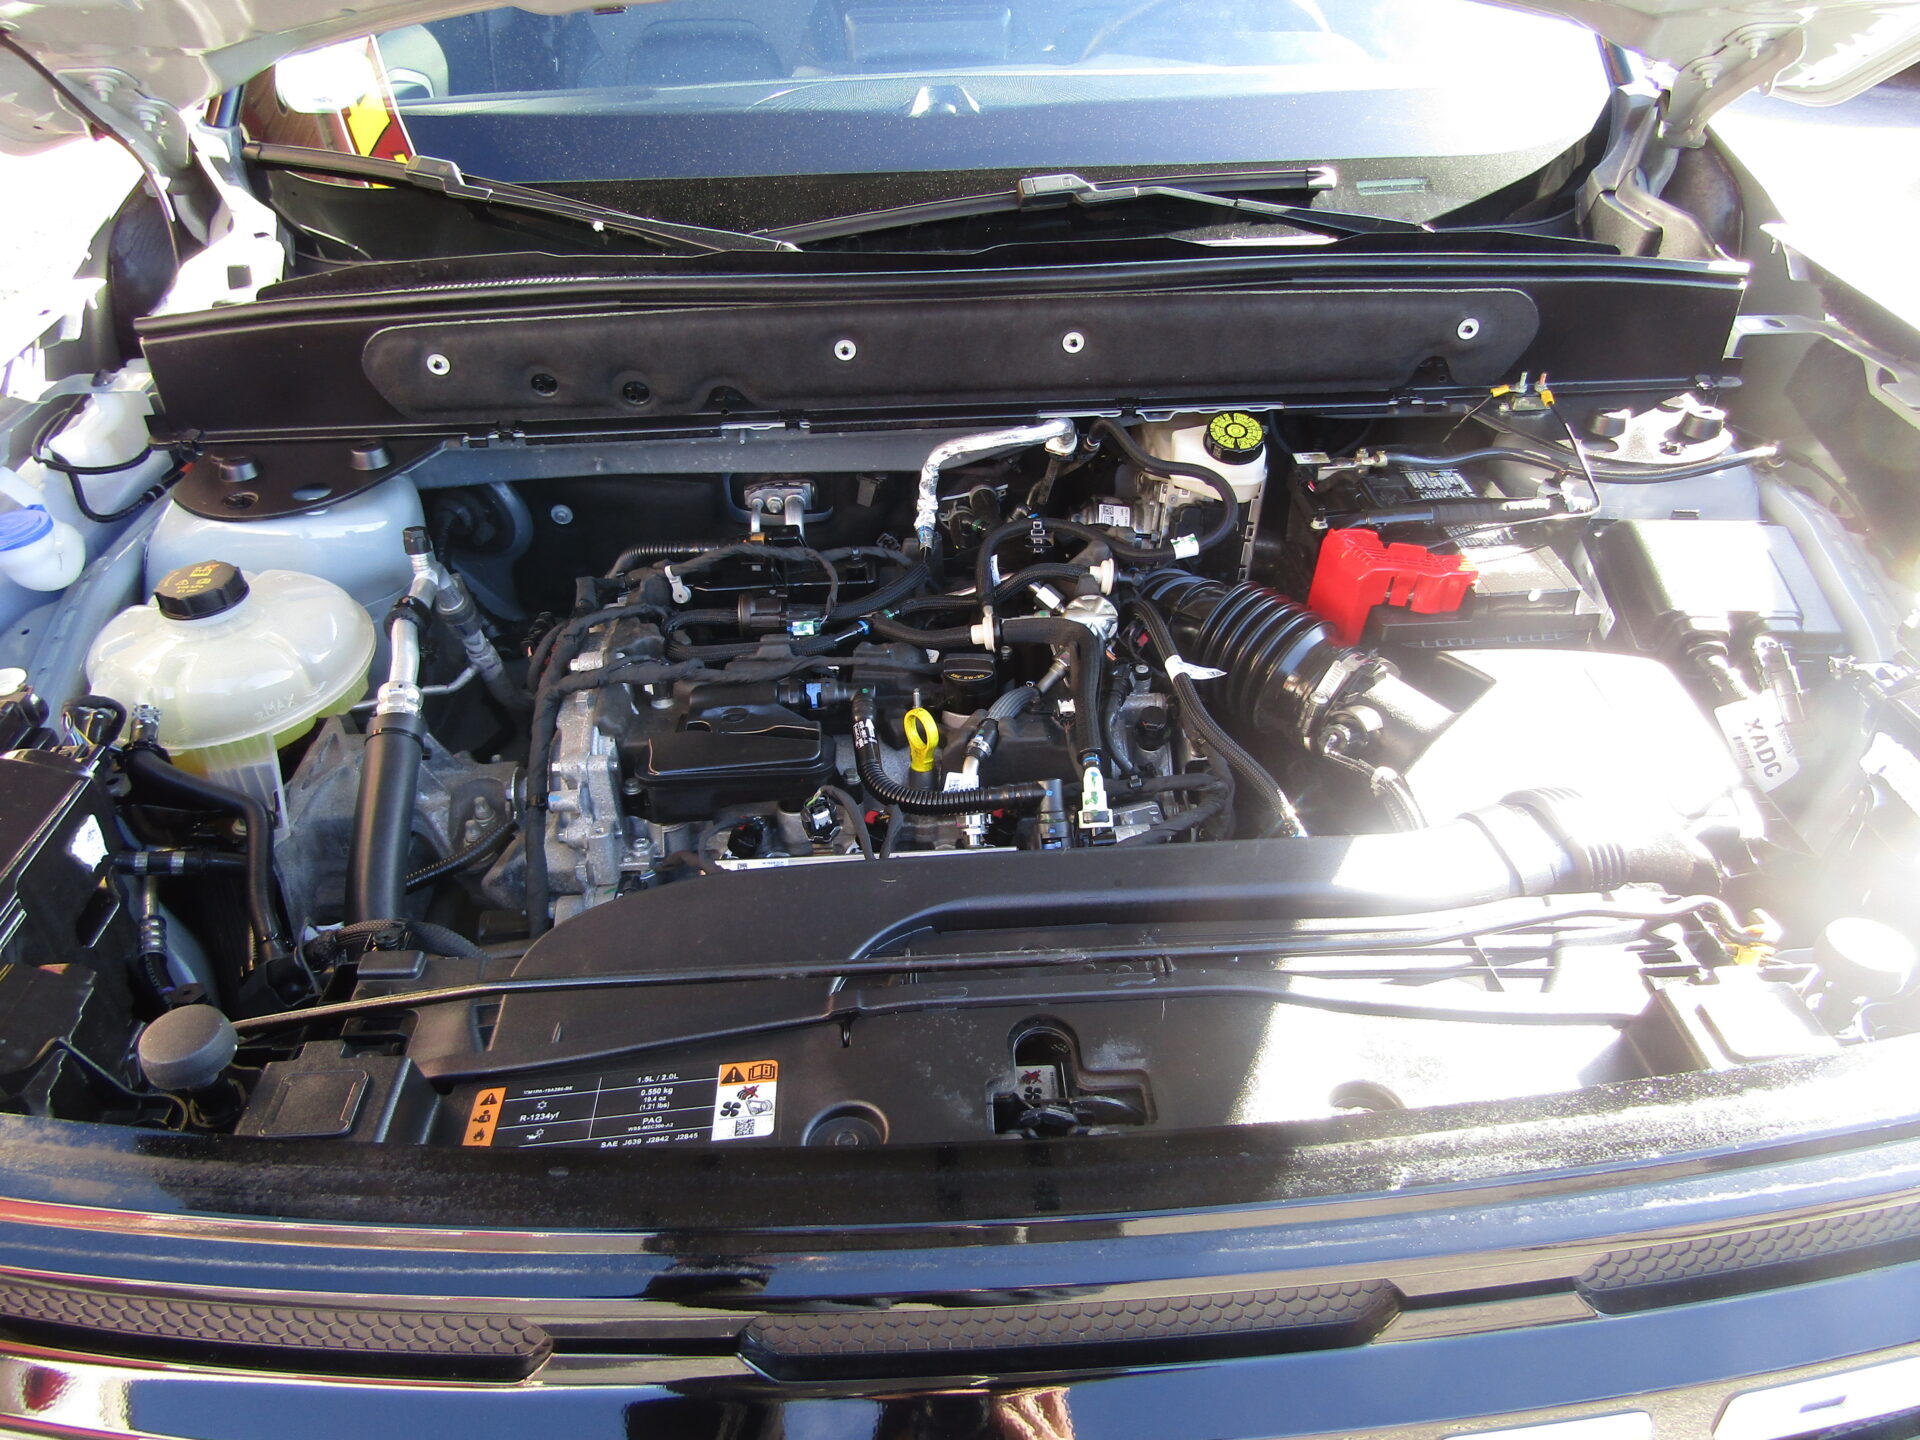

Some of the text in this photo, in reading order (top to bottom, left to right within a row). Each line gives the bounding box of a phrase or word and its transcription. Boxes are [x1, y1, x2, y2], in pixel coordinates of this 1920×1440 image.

[661, 1073, 679, 1081] 2.0L
[640, 1087, 673, 1096] 0.550 kg
[657, 1101, 670, 1110] lbs)
[519, 1111, 560, 1122] R-1234yf
[642, 1116, 663, 1125] PAG
[600, 1132, 699, 1149] SAE J639 J2842 J2845
